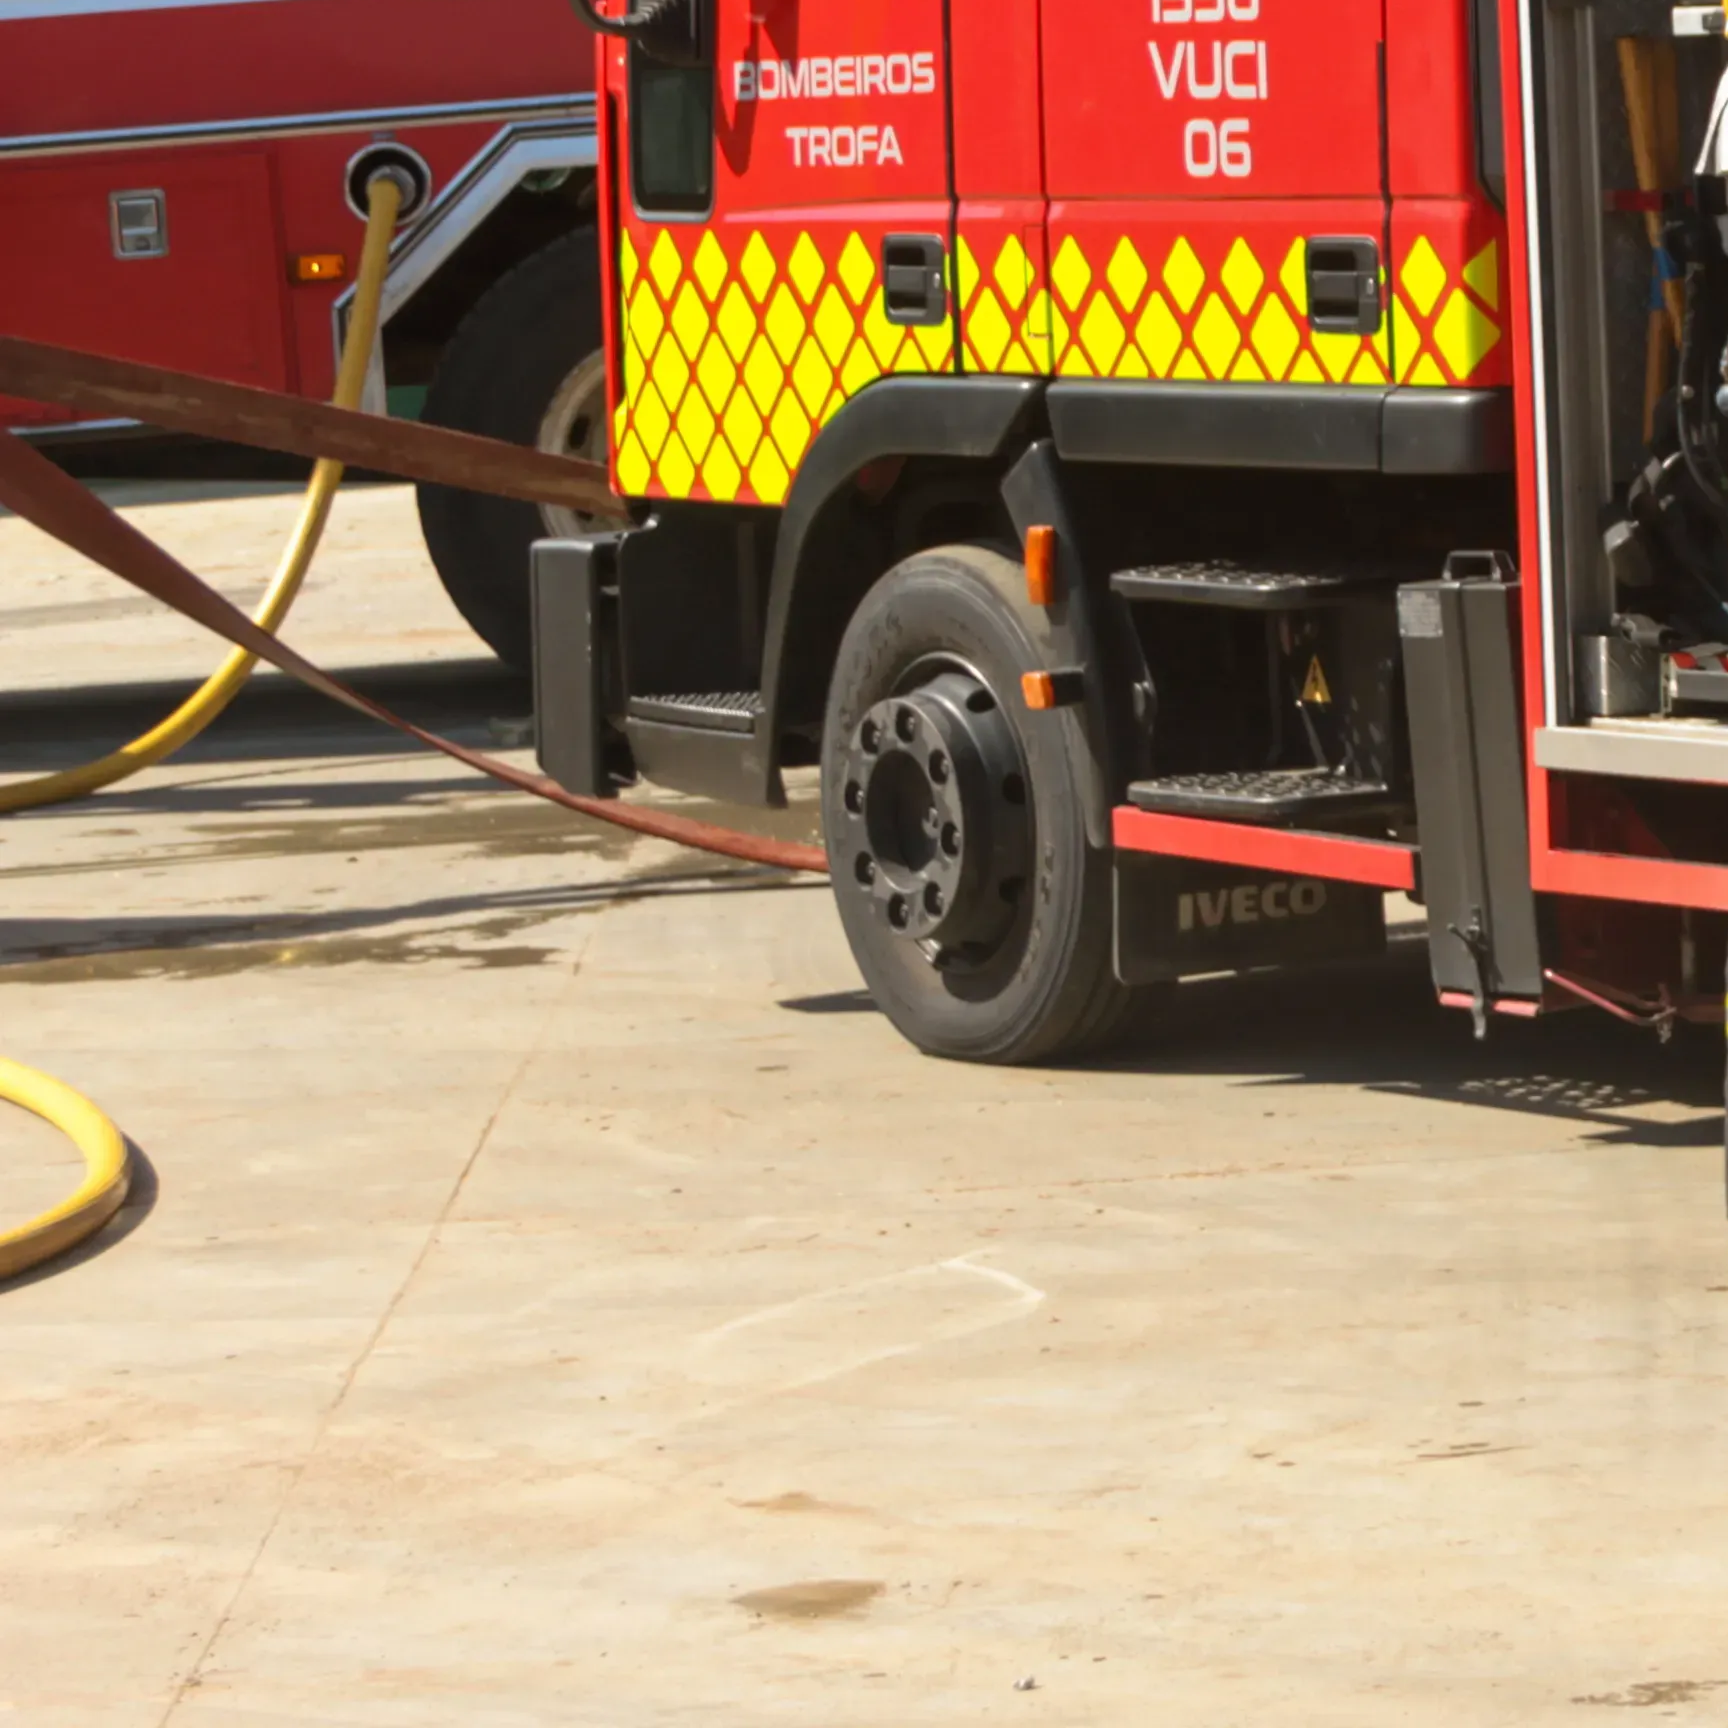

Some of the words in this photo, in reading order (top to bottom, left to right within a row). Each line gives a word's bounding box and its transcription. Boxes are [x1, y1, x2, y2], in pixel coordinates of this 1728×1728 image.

[733, 51, 936, 103] BOMBEIROS
[1147, 40, 1268, 101] VUCI
[785, 124, 904, 168] TROFA
[1183, 117, 1252, 179] 06
[1177, 880, 1328, 931] IVECO
